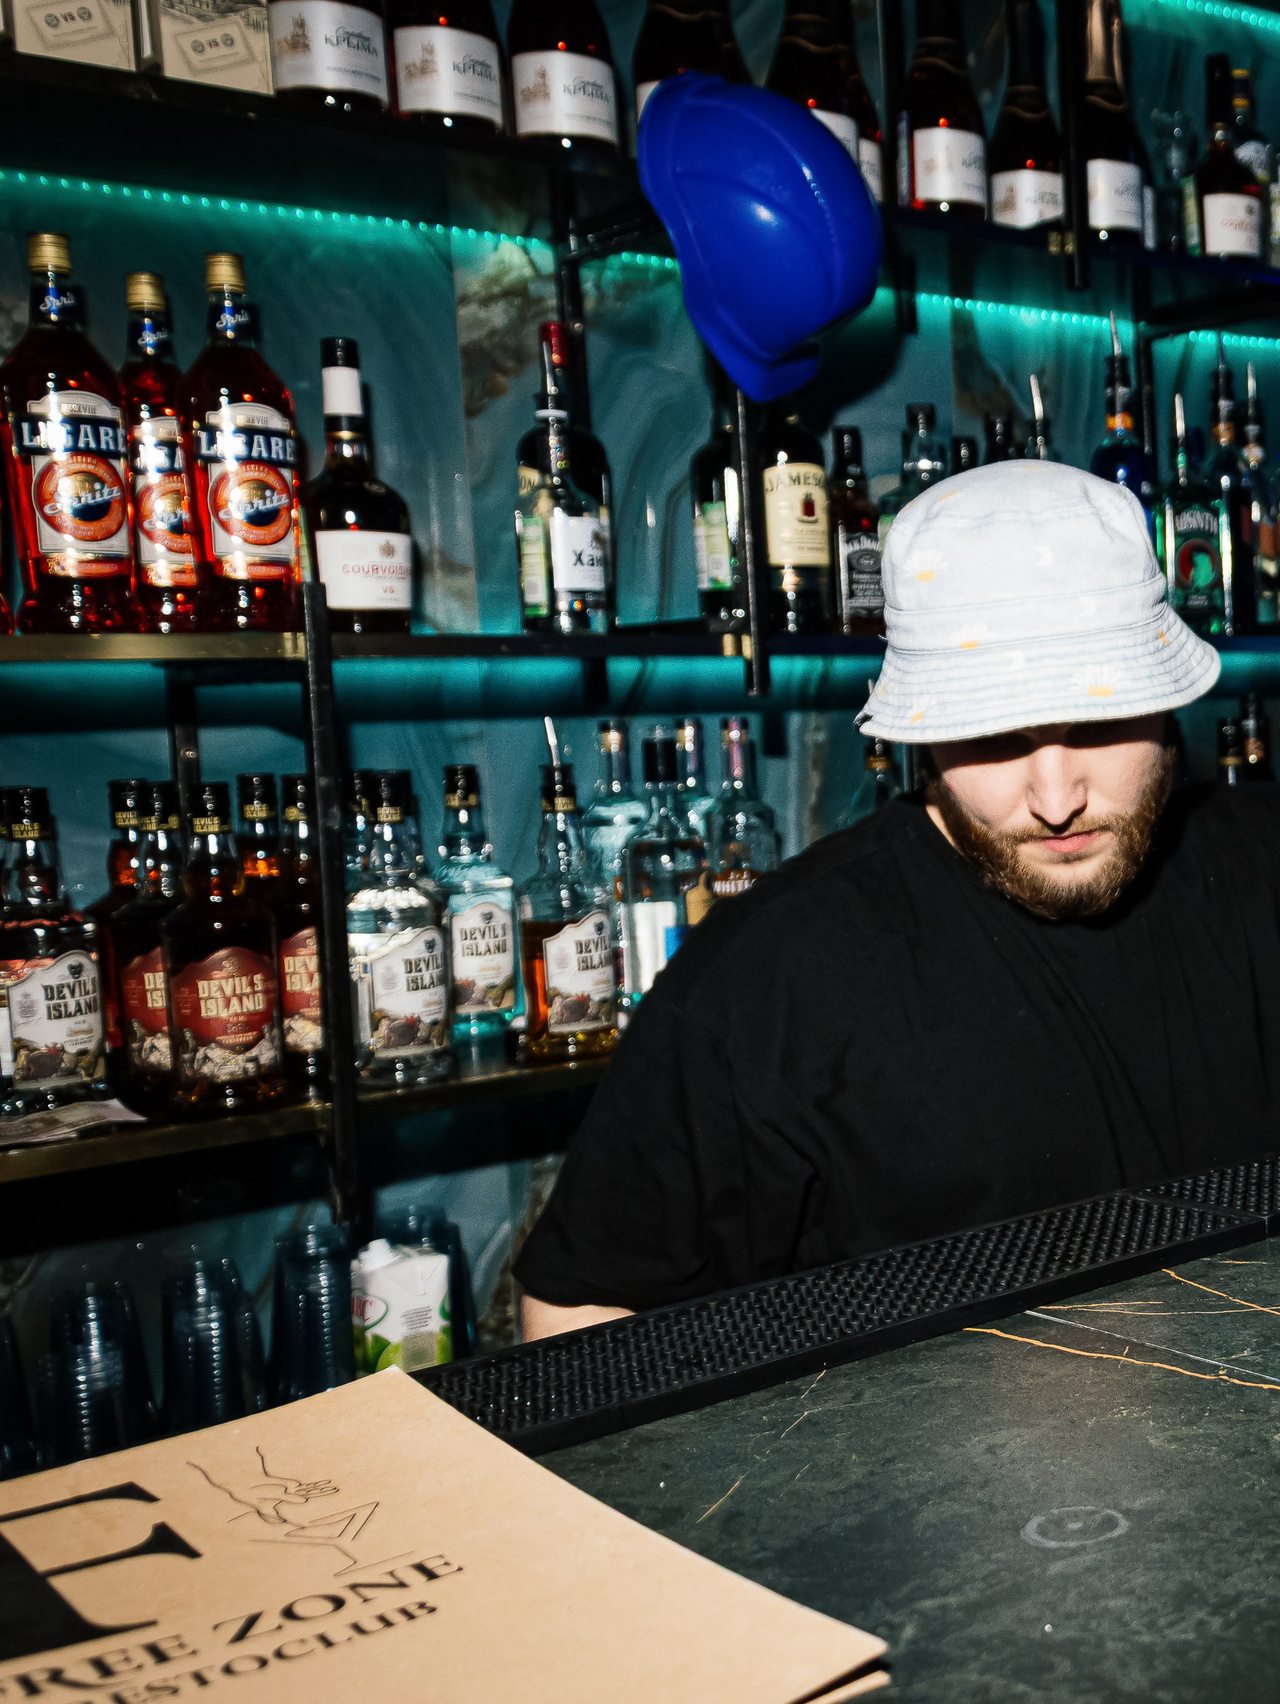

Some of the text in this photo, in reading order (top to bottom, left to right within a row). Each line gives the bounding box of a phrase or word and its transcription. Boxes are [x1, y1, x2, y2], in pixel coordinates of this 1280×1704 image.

[461, 939, 507, 957] ISLAND
[574, 934, 611, 954] DEVIL
[577, 951, 613, 971] ISLAN
[285, 972, 321, 992] ISLA
[405, 971, 444, 992] ISLAN
[199, 992, 266, 1018] ISLAND
[0, 1481, 203, 1663] F
[0, 1553, 464, 1697] REE ZONE
[65, 1600, 439, 1704] ESTOCLUB
